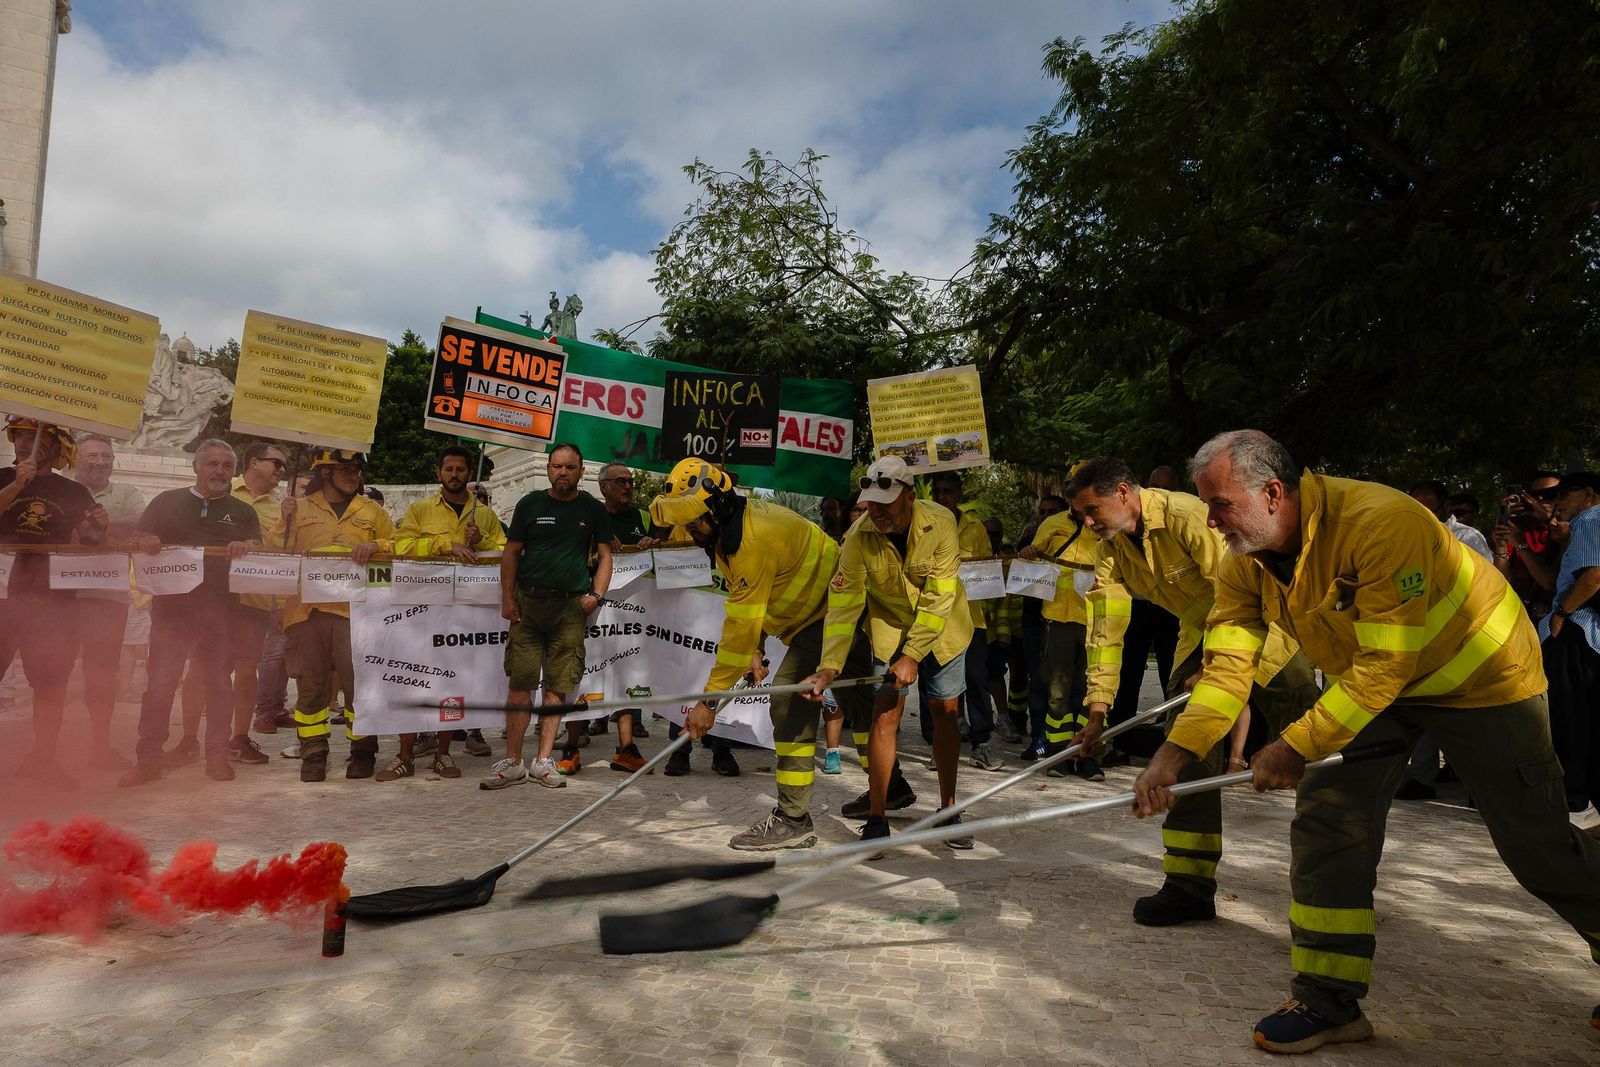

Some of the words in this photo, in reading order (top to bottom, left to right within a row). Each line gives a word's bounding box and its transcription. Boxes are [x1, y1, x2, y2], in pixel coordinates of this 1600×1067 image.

[2, 296, 29, 309] JUEGA
[32, 304, 50, 316] CON
[56, 312, 98, 330] NUESTROS
[26, 286, 38, 294] PP
[40, 290, 51, 298] DE
[53, 294, 88, 310] JUANMA
[93, 306, 129, 322] MORENO
[6, 330, 60, 352] ESTABILIDAD
[258, 334, 302, 350] DESPILFARRA
[314, 346, 340, 358] DINERO
[298, 328, 326, 342] JUANMA
[330, 336, 360, 348] MORENO
[0, 348, 44, 364] TRASLADO
[46, 357, 56, 366] NI
[60, 362, 107, 380] MOVILIDAD
[282, 356, 316, 368] MILLONES
[344, 366, 379, 380] CAMIONES
[441, 334, 476, 366] SE
[481, 343, 561, 386] VENDE
[260, 366, 306, 379] AUTOBOMBA
[311, 376, 326, 384] CON
[327, 378, 366, 392] PROBLEMAS
[909, 380, 931, 388] JUANMA
[932, 376, 956, 386] MORENO
[48, 376, 91, 392] ESPECÍFICA
[100, 389, 110, 397] DE
[111, 392, 144, 406] CALIDAD
[262, 380, 302, 393] MECÁNICOS
[312, 390, 344, 402] TÉCNICOS
[346, 396, 360, 404] QUE
[467, 376, 552, 408] INFOCA
[564, 376, 646, 420] EROS
[672, 376, 767, 409] INFOCA
[878, 392, 912, 402] DESPILFARRA
[920, 388, 940, 396] DINERO
[54, 394, 98, 410] COLECTIVA
[244, 392, 300, 408] COMPROMETEN
[302, 402, 332, 414] NUESTRA
[334, 408, 371, 421] SEGURIDAD
[490, 406, 524, 417] PREGUNTAR
[896, 400, 924, 410] MILLONES
[945, 394, 981, 403] FURGONETAS
[918, 408, 946, 417] TERRENOS
[947, 404, 980, 413] FORESTALES
[478, 414, 506, 424] JUANMA
[506, 418, 531, 428] MORENO
[682, 432, 718, 456] 100
[916, 431, 940, 439] SERVIDO
[60, 570, 120, 578] ESTAMOS
[143, 564, 197, 575] VENDIDOS
[233, 566, 296, 577] ANDALUCÍA
[324, 572, 360, 582] QUEMA
[395, 576, 451, 584] BOMBEROS
[1024, 578, 1055, 588] PERMUTAS
[1401, 572, 1422, 588] 112
[384, 612, 402, 625] SIN
[406, 604, 429, 618] EPIS
[646, 624, 671, 642] SIN
[365, 655, 384, 665] SIN
[388, 660, 456, 679] ESTABILIDAD
[382, 673, 432, 689] LABORAL
